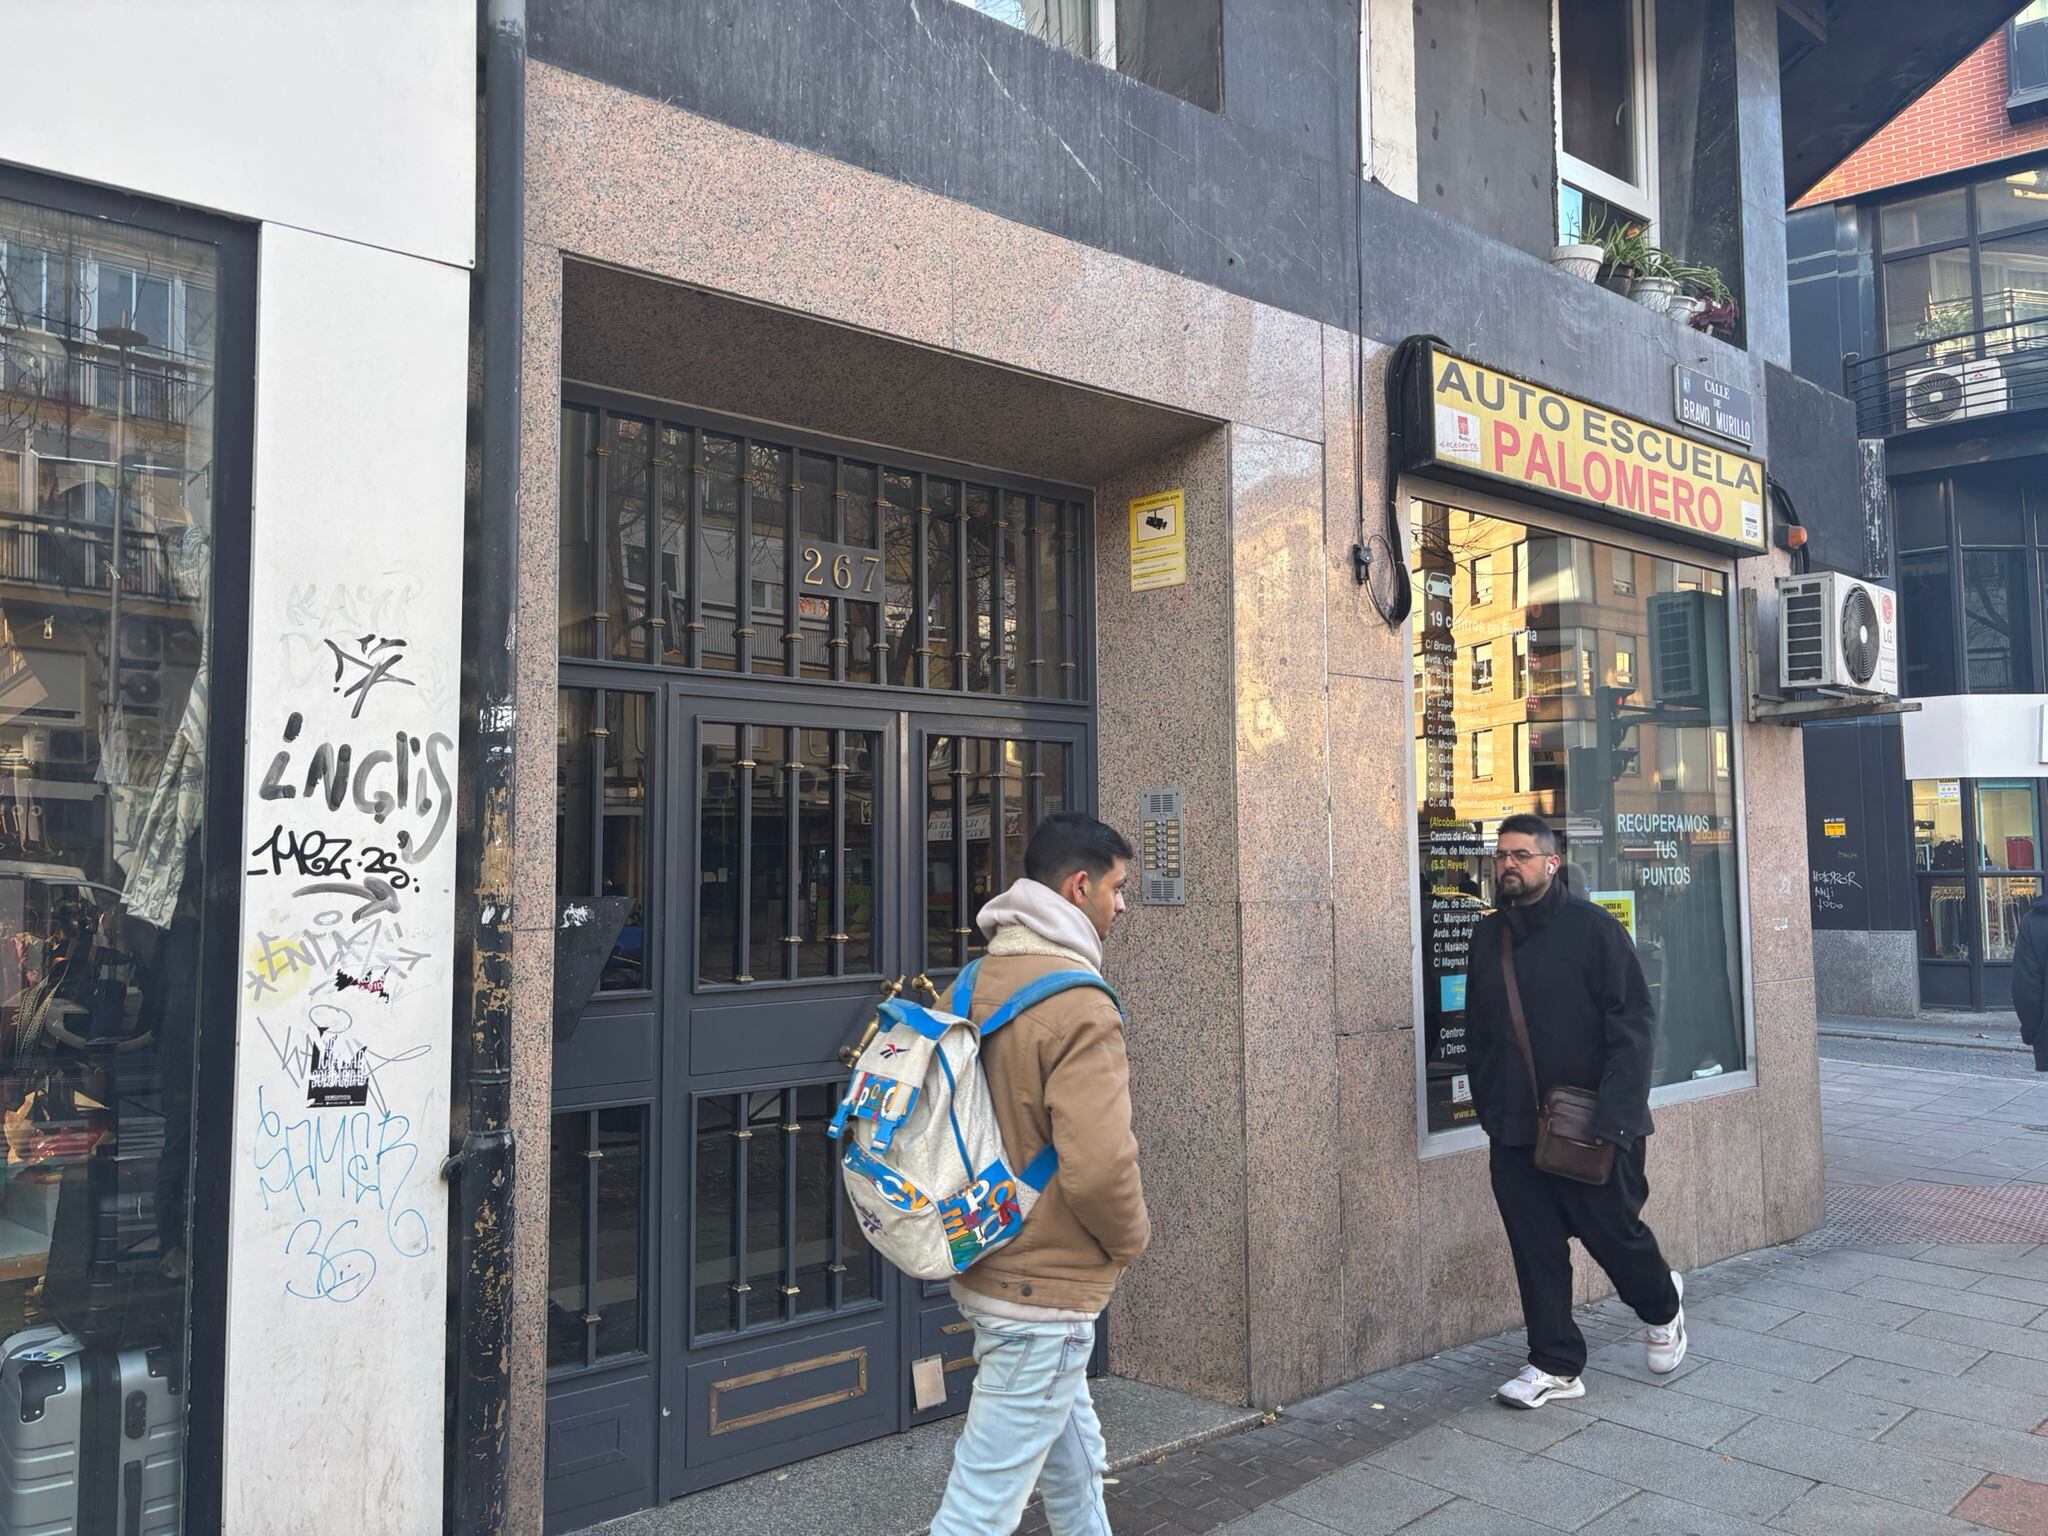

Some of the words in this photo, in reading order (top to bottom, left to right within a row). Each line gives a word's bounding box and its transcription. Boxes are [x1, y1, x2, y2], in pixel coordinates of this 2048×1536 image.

[1704, 379, 1730, 400] CALLE
[1713, 398, 1721, 409] DE
[1683, 398, 1711, 426] BRAVO
[1715, 410, 1751, 440] MURILLO
[1437, 361, 1571, 432] AUTO
[1583, 408, 1759, 495] ESCUELA
[1493, 420, 1723, 533] PALOMERO
[803, 547, 880, 593] 267
[1430, 610, 1443, 627] 19
[1883, 627, 1893, 644] LG
[1434, 641, 1452, 652] Bravo
[1437, 697, 1453, 709] Lope
[1439, 798, 1448, 807] de
[1617, 814, 1709, 833] RECUPERAMOS
[1430, 831, 1451, 841] Centro
[1453, 832, 1461, 840] de
[1430, 846, 1447, 855] Avda.
[1449, 846, 1457, 855] de
[1654, 841, 1677, 859] TUS
[1447, 860, 1468, 871] Reyes)
[1642, 867, 1691, 886] PUNTOS
[1432, 885, 1459, 895] Asturias
[1432, 899, 1449, 909] Avda.
[1451, 899, 1459, 908] de
[1444, 913, 1470, 925] Marques
[1471, 912, 1480, 922] de
[1433, 928, 1450, 938] Avda.
[1452, 928, 1460, 937] de
[1445, 941, 1469, 953] Naranjo
[1442, 957, 1465, 968] Magnus
[1440, 1046, 1446, 1058] y
